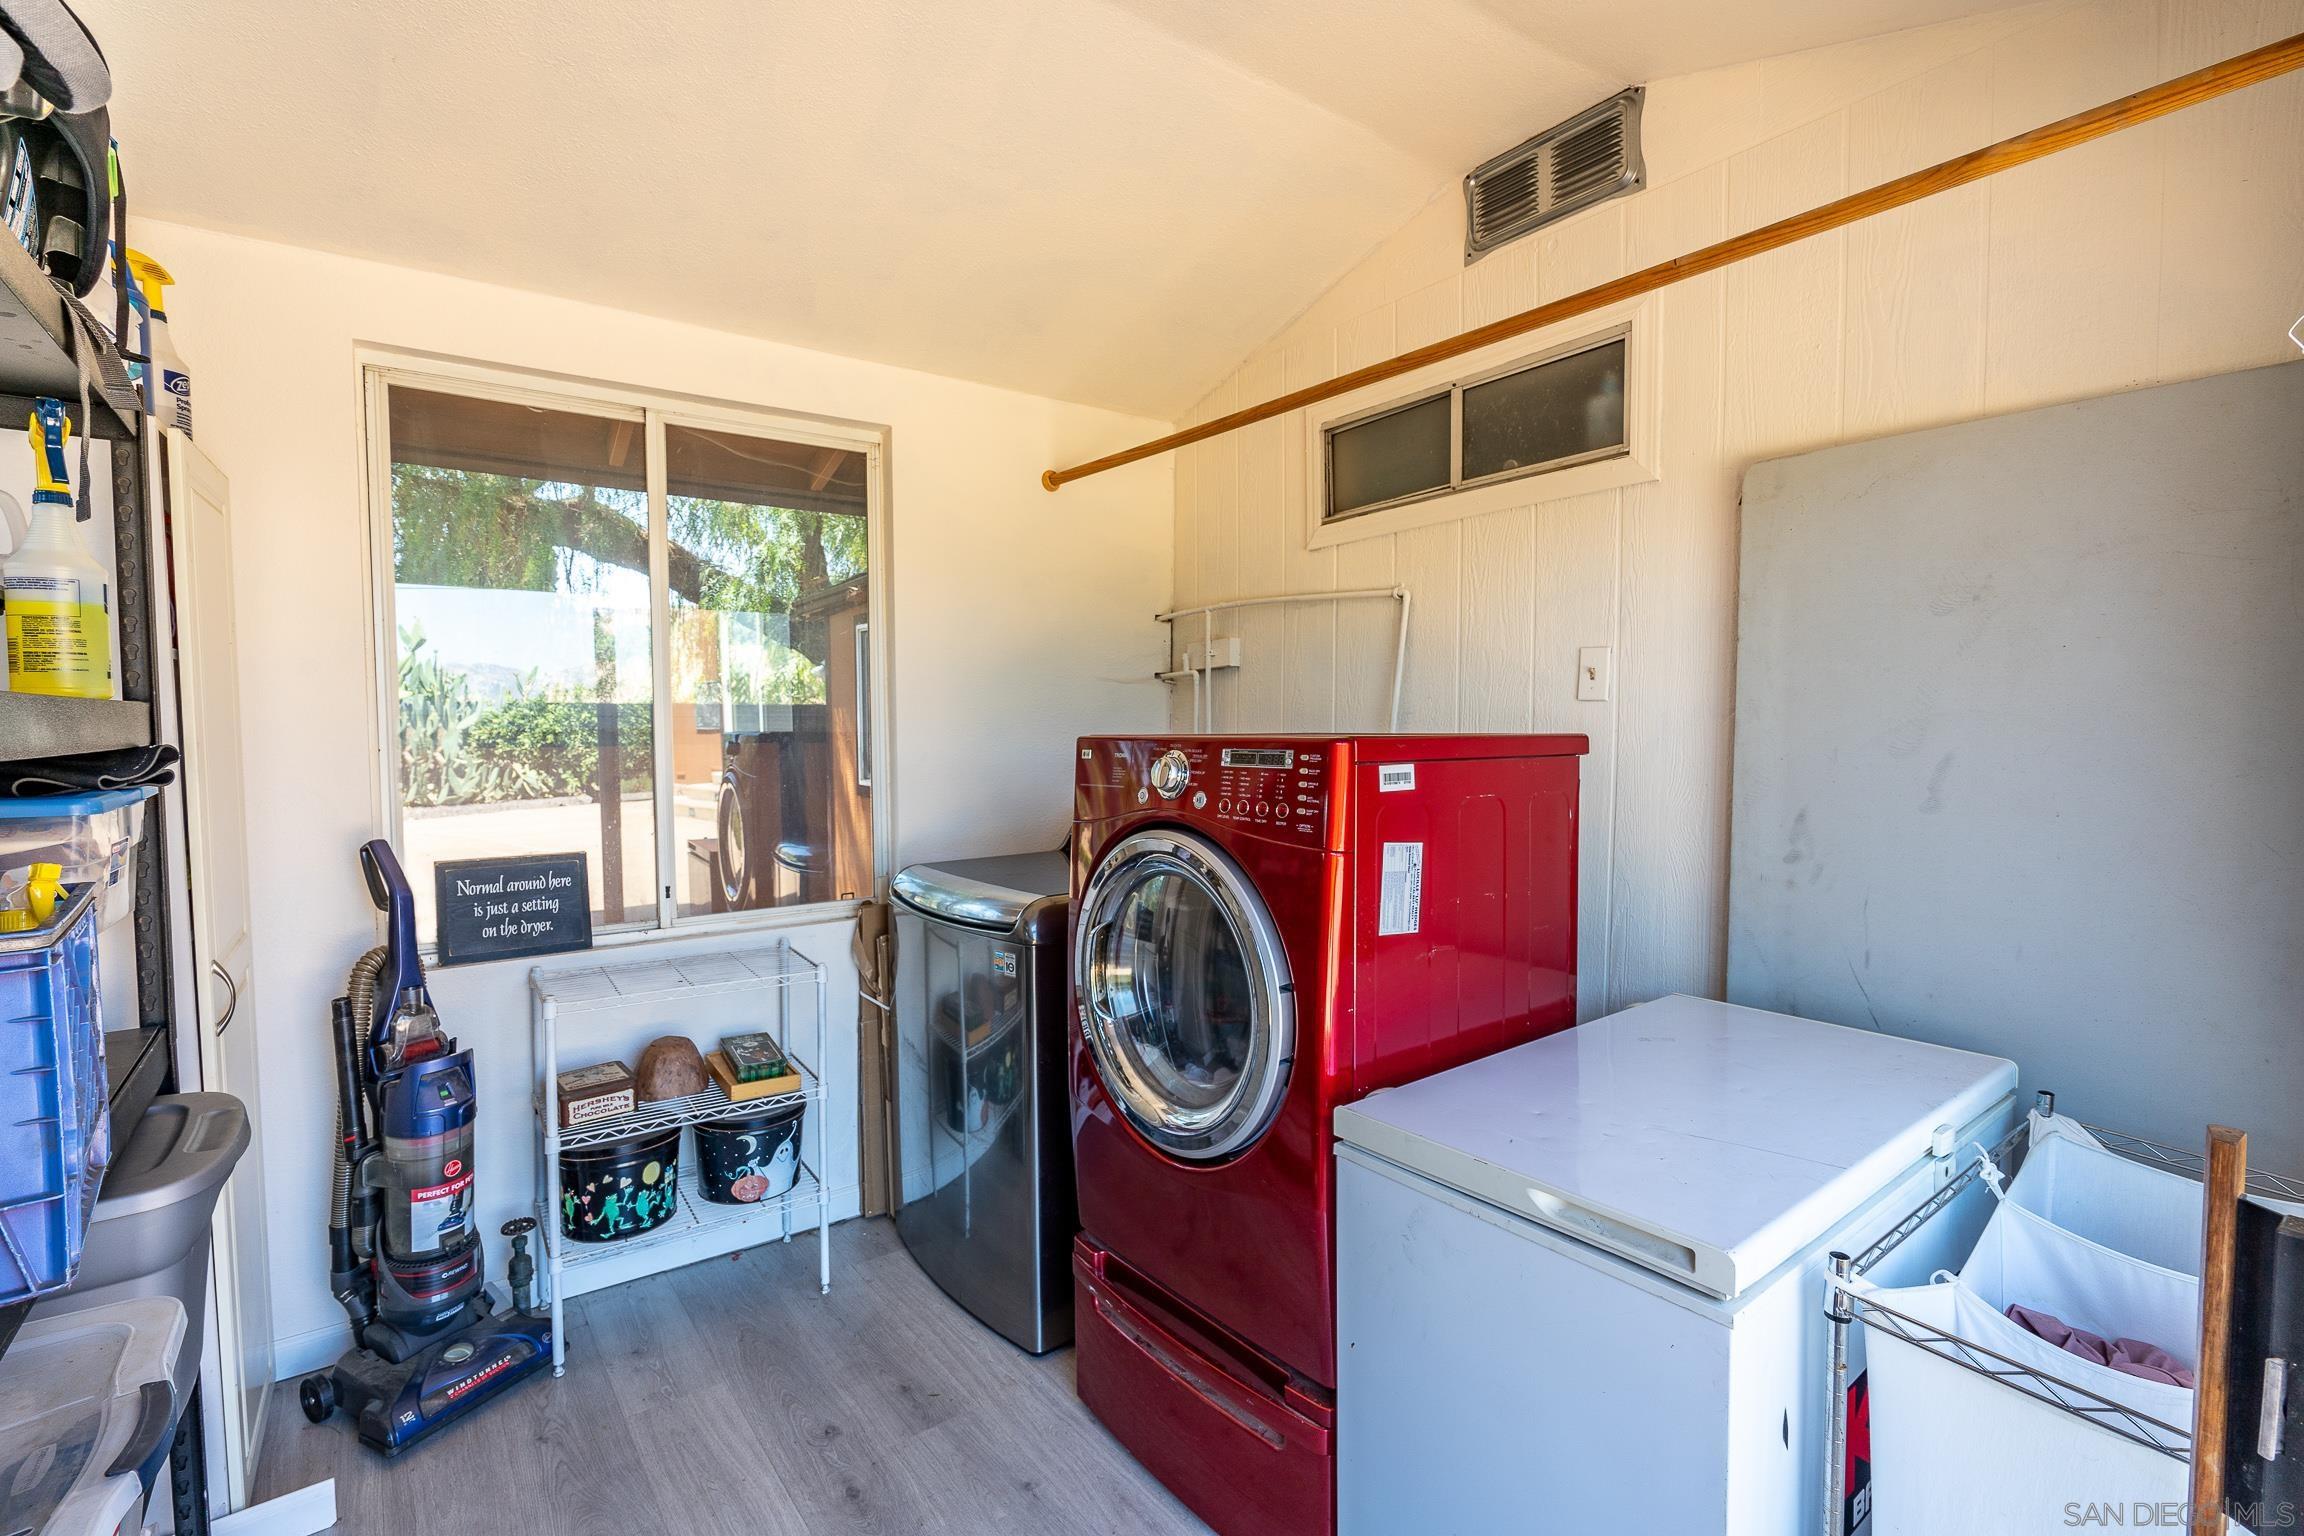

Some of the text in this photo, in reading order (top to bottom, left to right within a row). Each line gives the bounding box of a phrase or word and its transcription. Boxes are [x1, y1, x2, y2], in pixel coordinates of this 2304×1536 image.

[456, 871, 572, 896] Normal around here
[473, 896, 559, 920] is just a setting
[482, 917, 554, 938] on the dryer.
[573, 1103, 630, 1120] CHOCOLATE
[417, 1187, 450, 1200] PERFECT
[451, 1180, 465, 1191] FOR
[400, 1410, 415, 1424] 12
